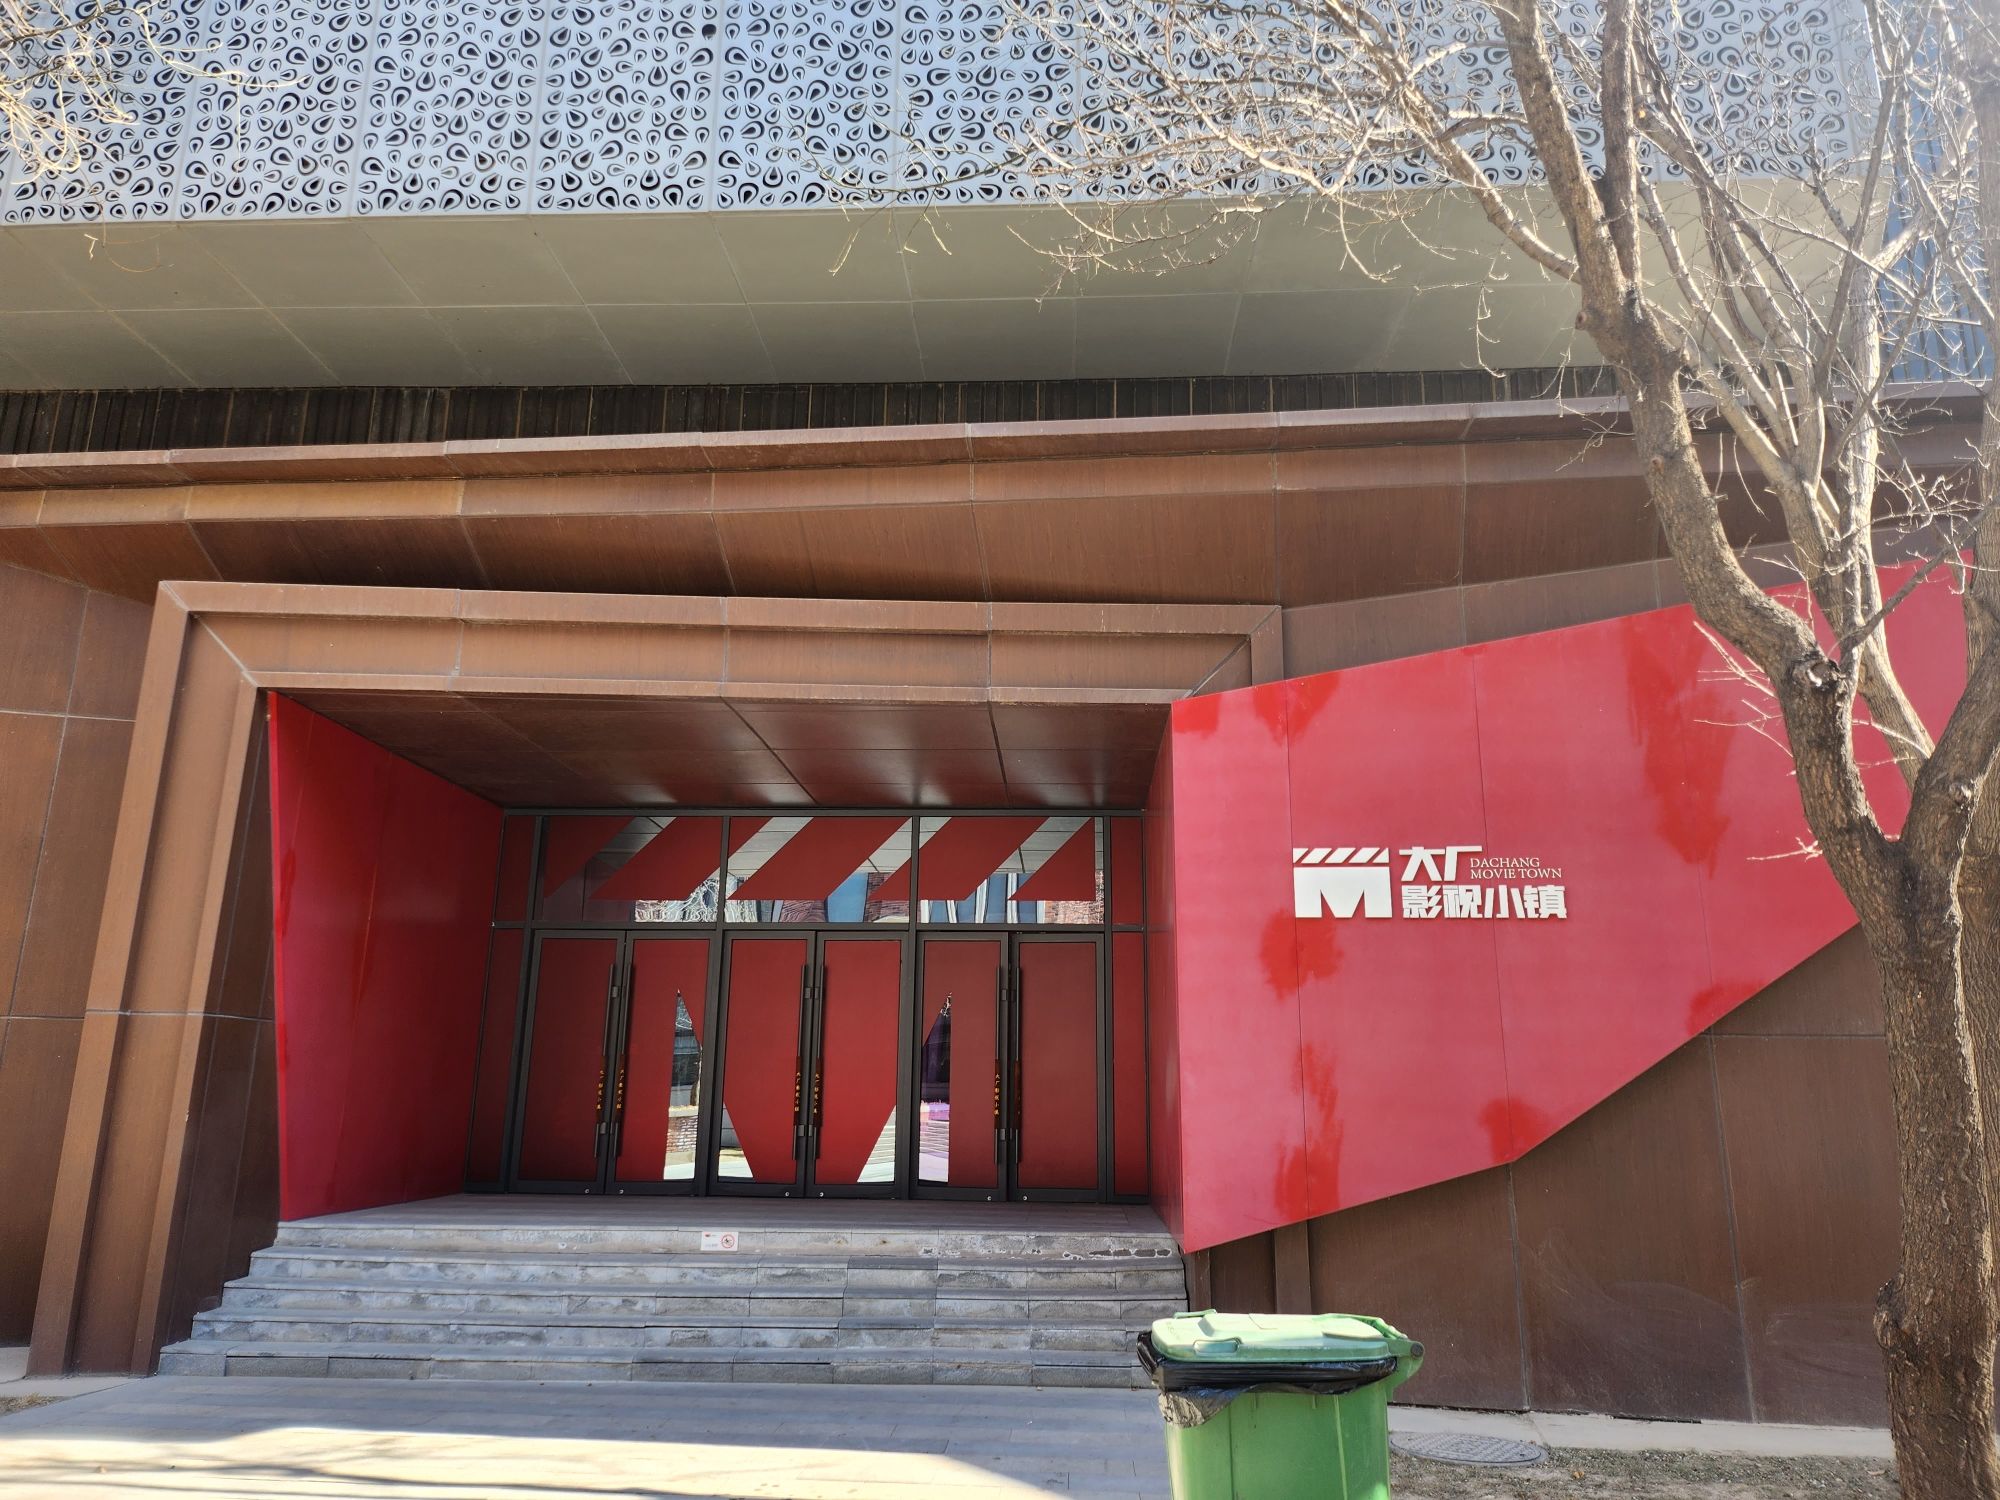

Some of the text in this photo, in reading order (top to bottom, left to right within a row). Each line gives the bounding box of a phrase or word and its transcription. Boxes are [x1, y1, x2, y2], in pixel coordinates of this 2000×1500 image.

[1398, 845, 1483, 882] 大厂
[1469, 857, 1541, 868] DACHANG
[1470, 867, 1563, 880] MOVIE TOWN
[1401, 884, 1568, 919] 影视小镇
